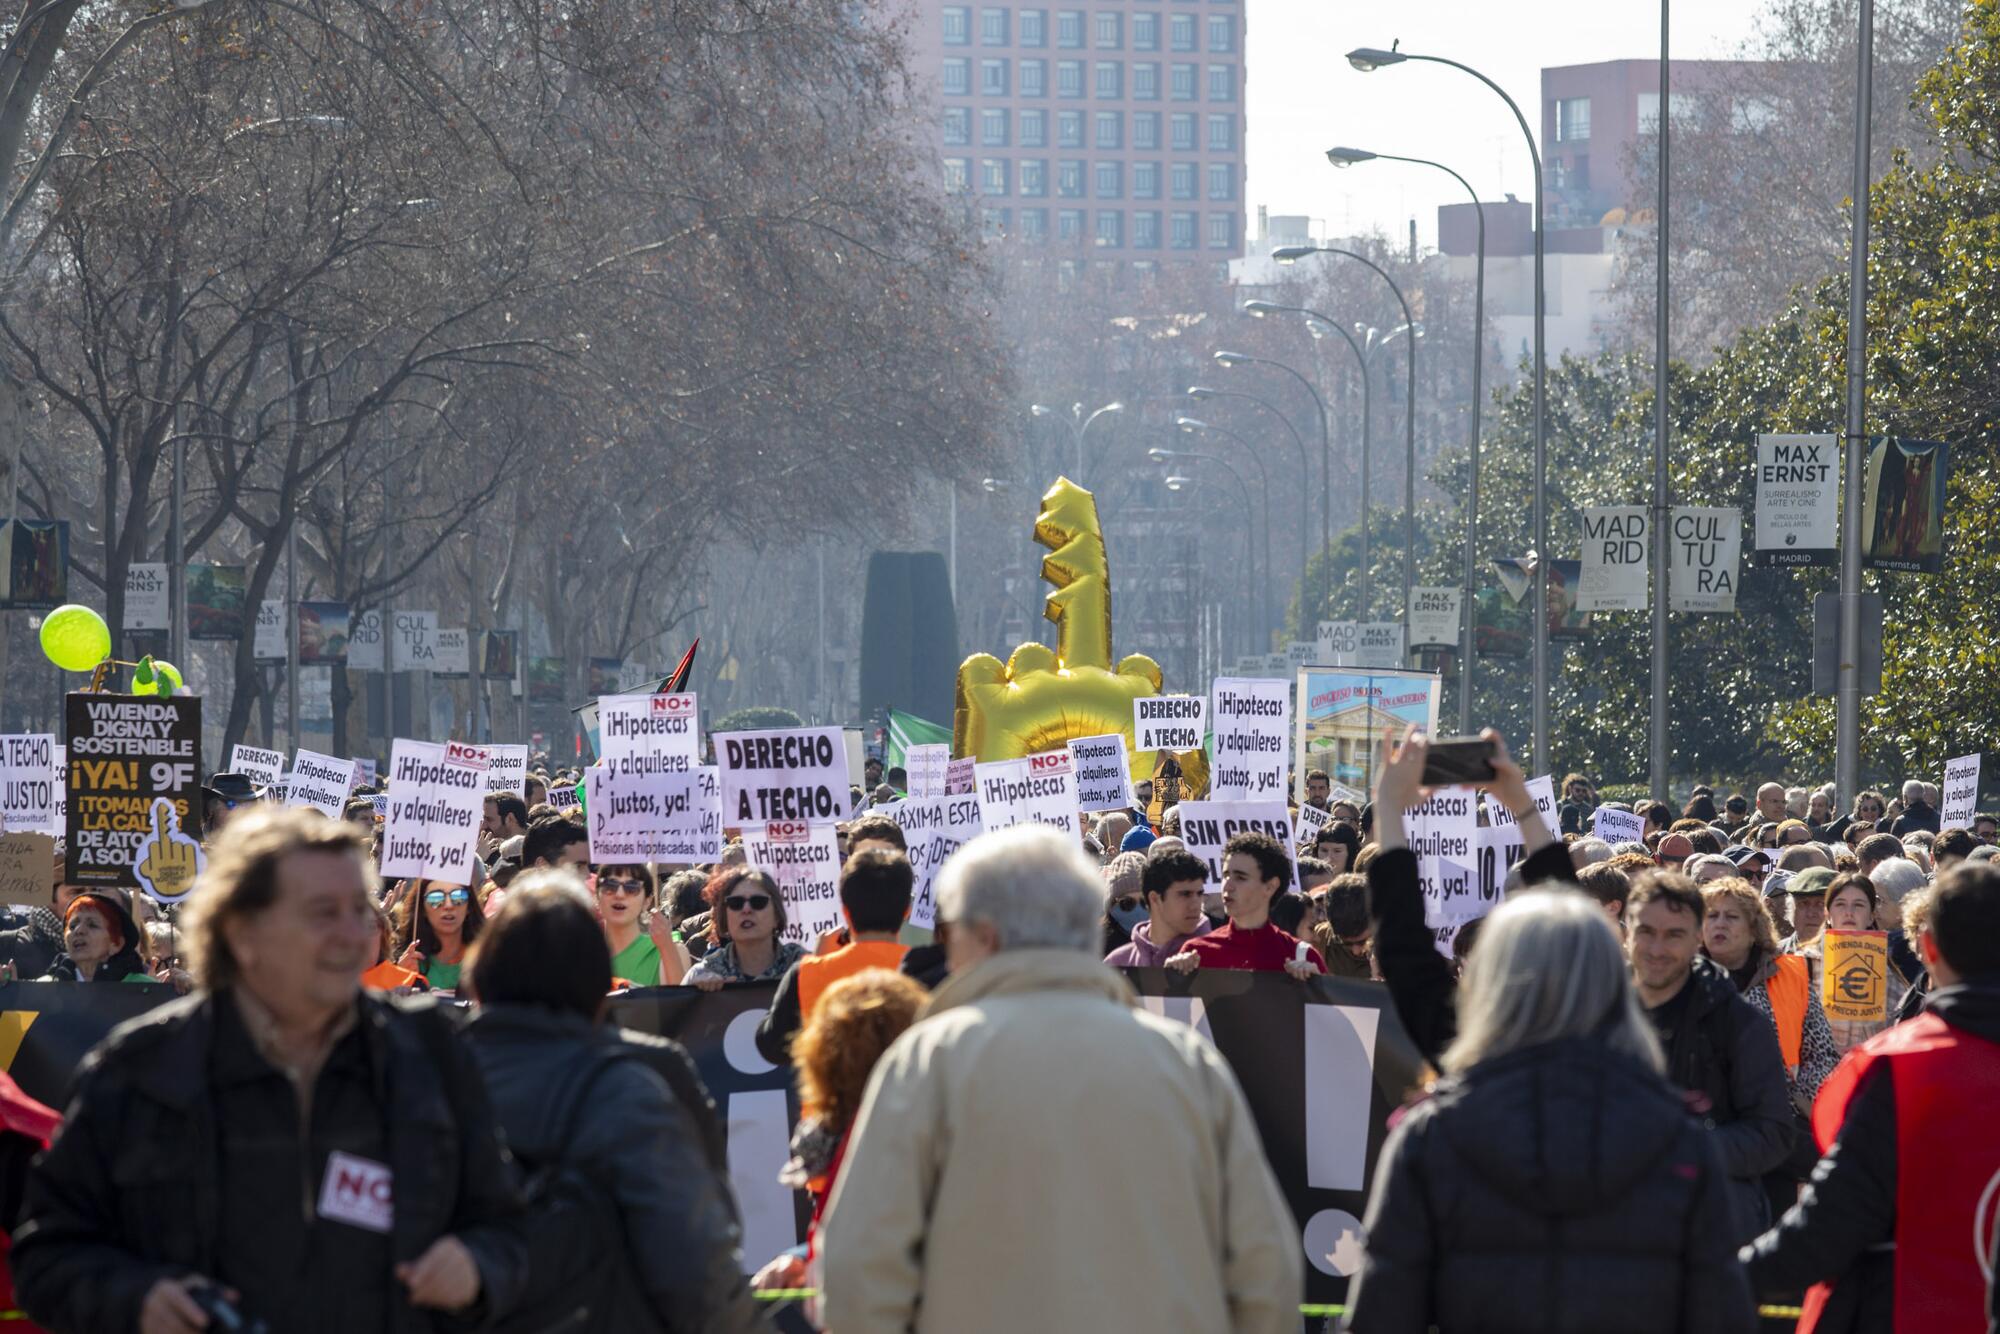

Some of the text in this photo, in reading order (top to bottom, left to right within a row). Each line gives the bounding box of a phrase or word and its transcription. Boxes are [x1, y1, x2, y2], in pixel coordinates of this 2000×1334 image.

[1774, 445, 1820, 463] MAX
[1763, 465, 1830, 483] ERNST
[1764, 490, 1821, 499] SURREALISMO
[1767, 499, 1817, 507] ARTE Y CINE
[1584, 516, 1645, 540] MAD
[1675, 515, 1726, 541] CUL
[1603, 541, 1643, 565] RID
[1682, 542, 1716, 567] TU
[1779, 554, 1812, 562] MADRID
[1874, 559, 1921, 570] max-ernst.es
[126, 581, 164, 592] RNST
[1698, 570, 1733, 593] RA
[1414, 602, 1456, 611] ERNST
[1421, 592, 1450, 602] MAX
[396, 616, 428, 631] CUL
[1319, 626, 1355, 639] MAD
[1366, 628, 1391, 637] MAX
[354, 630, 379, 643] RID
[404, 631, 423, 644] TU
[1332, 639, 1355, 652] RID
[1361, 637, 1396, 647] ERNST
[412, 645, 434, 659] RA
[653, 698, 691, 710] NO+
[1219, 691, 1283, 719] ¡Hipotecas
[1311, 686, 1351, 709] CONGRESO
[1379, 692, 1427, 708] FINANCIEROS
[87, 703, 179, 722] VIVIENDA
[1139, 700, 1201, 719] DERECHO
[93, 721, 173, 738] DIGNA Y
[607, 711, 689, 740] ¡Hipotecas
[73, 737, 193, 756] SOSTENIBLE
[1144, 727, 1199, 747] A TECHO.
[1217, 728, 1281, 755] y alquileres
[9, 739, 53, 772] TECHO,
[237, 748, 279, 767] DERECHO
[449, 744, 487, 760] NO+
[726, 734, 833, 770] DERECHO
[1073, 744, 1116, 761] ¡Hipotecas
[608, 749, 689, 780] y alquileres
[1031, 754, 1069, 770] NO+
[72, 760, 195, 791] ¡YA! 9F
[296, 759, 347, 785] ¡Hipotecas
[397, 757, 478, 790] ¡Hipotecas
[1075, 764, 1118, 784] y alquileres
[1216, 764, 1280, 793] justos, ya!
[485, 775, 521, 792] lquileres
[984, 776, 1065, 806] ¡Hipotecas
[3, 781, 53, 810] JUSTO!
[290, 786, 298, 801] y
[299, 785, 341, 809] alquileres
[610, 784, 660, 817] justos,
[664, 787, 690, 817] ya!
[738, 789, 753, 820] A
[757, 785, 841, 820] TECHO.
[1078, 783, 1121, 804] justos, ya!
[1946, 792, 1951, 804] y
[4, 813, 49, 824] Esclavitud.
[392, 802, 404, 826] y
[404, 797, 473, 827] alquileres
[1944, 808, 1967, 823] justos,
[83, 814, 112, 830] LA
[769, 823, 805, 835] NO+
[1601, 812, 1640, 834] Alquileres,
[77, 831, 104, 847] DE
[1185, 820, 1221, 846] SIN
[388, 836, 468, 869] justos, ya!
[594, 841, 718, 858] Prisiones hipotecadas, NO!
[1408, 831, 1468, 860] lquileres
[78, 848, 94, 865] A
[752, 842, 830, 869] ¡Hipotecas
[778, 877, 834, 907] lquileres
[1443, 871, 1469, 901] ya!
[1828, 941, 1886, 956] VIVIENDA DIGNA
[1832, 1005, 1858, 1016] PRECIO
[1860, 1006, 1883, 1016] JUSTO
